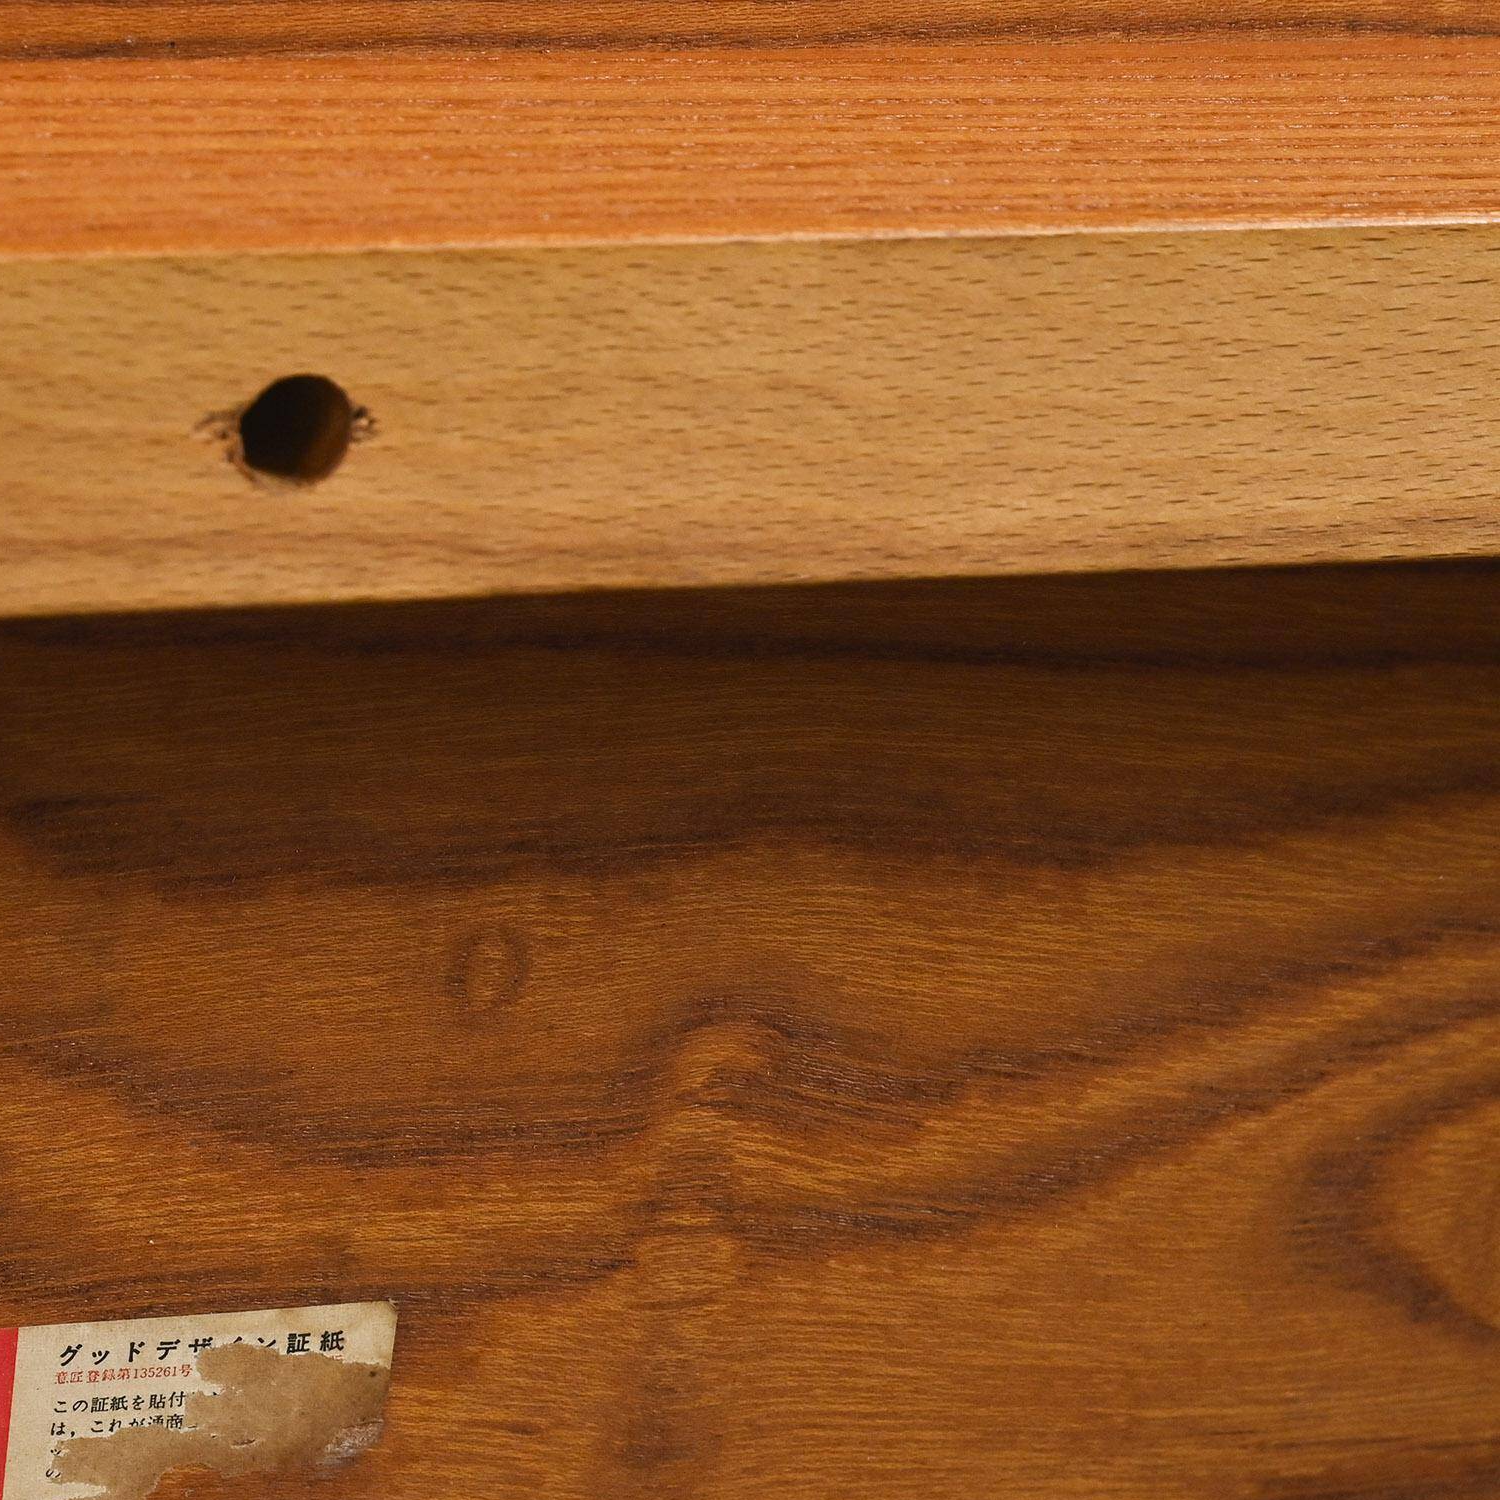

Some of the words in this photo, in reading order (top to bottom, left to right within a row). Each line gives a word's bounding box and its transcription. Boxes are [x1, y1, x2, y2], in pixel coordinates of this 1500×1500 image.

[60, 1329, 345, 1367] グッドデザン証紙
